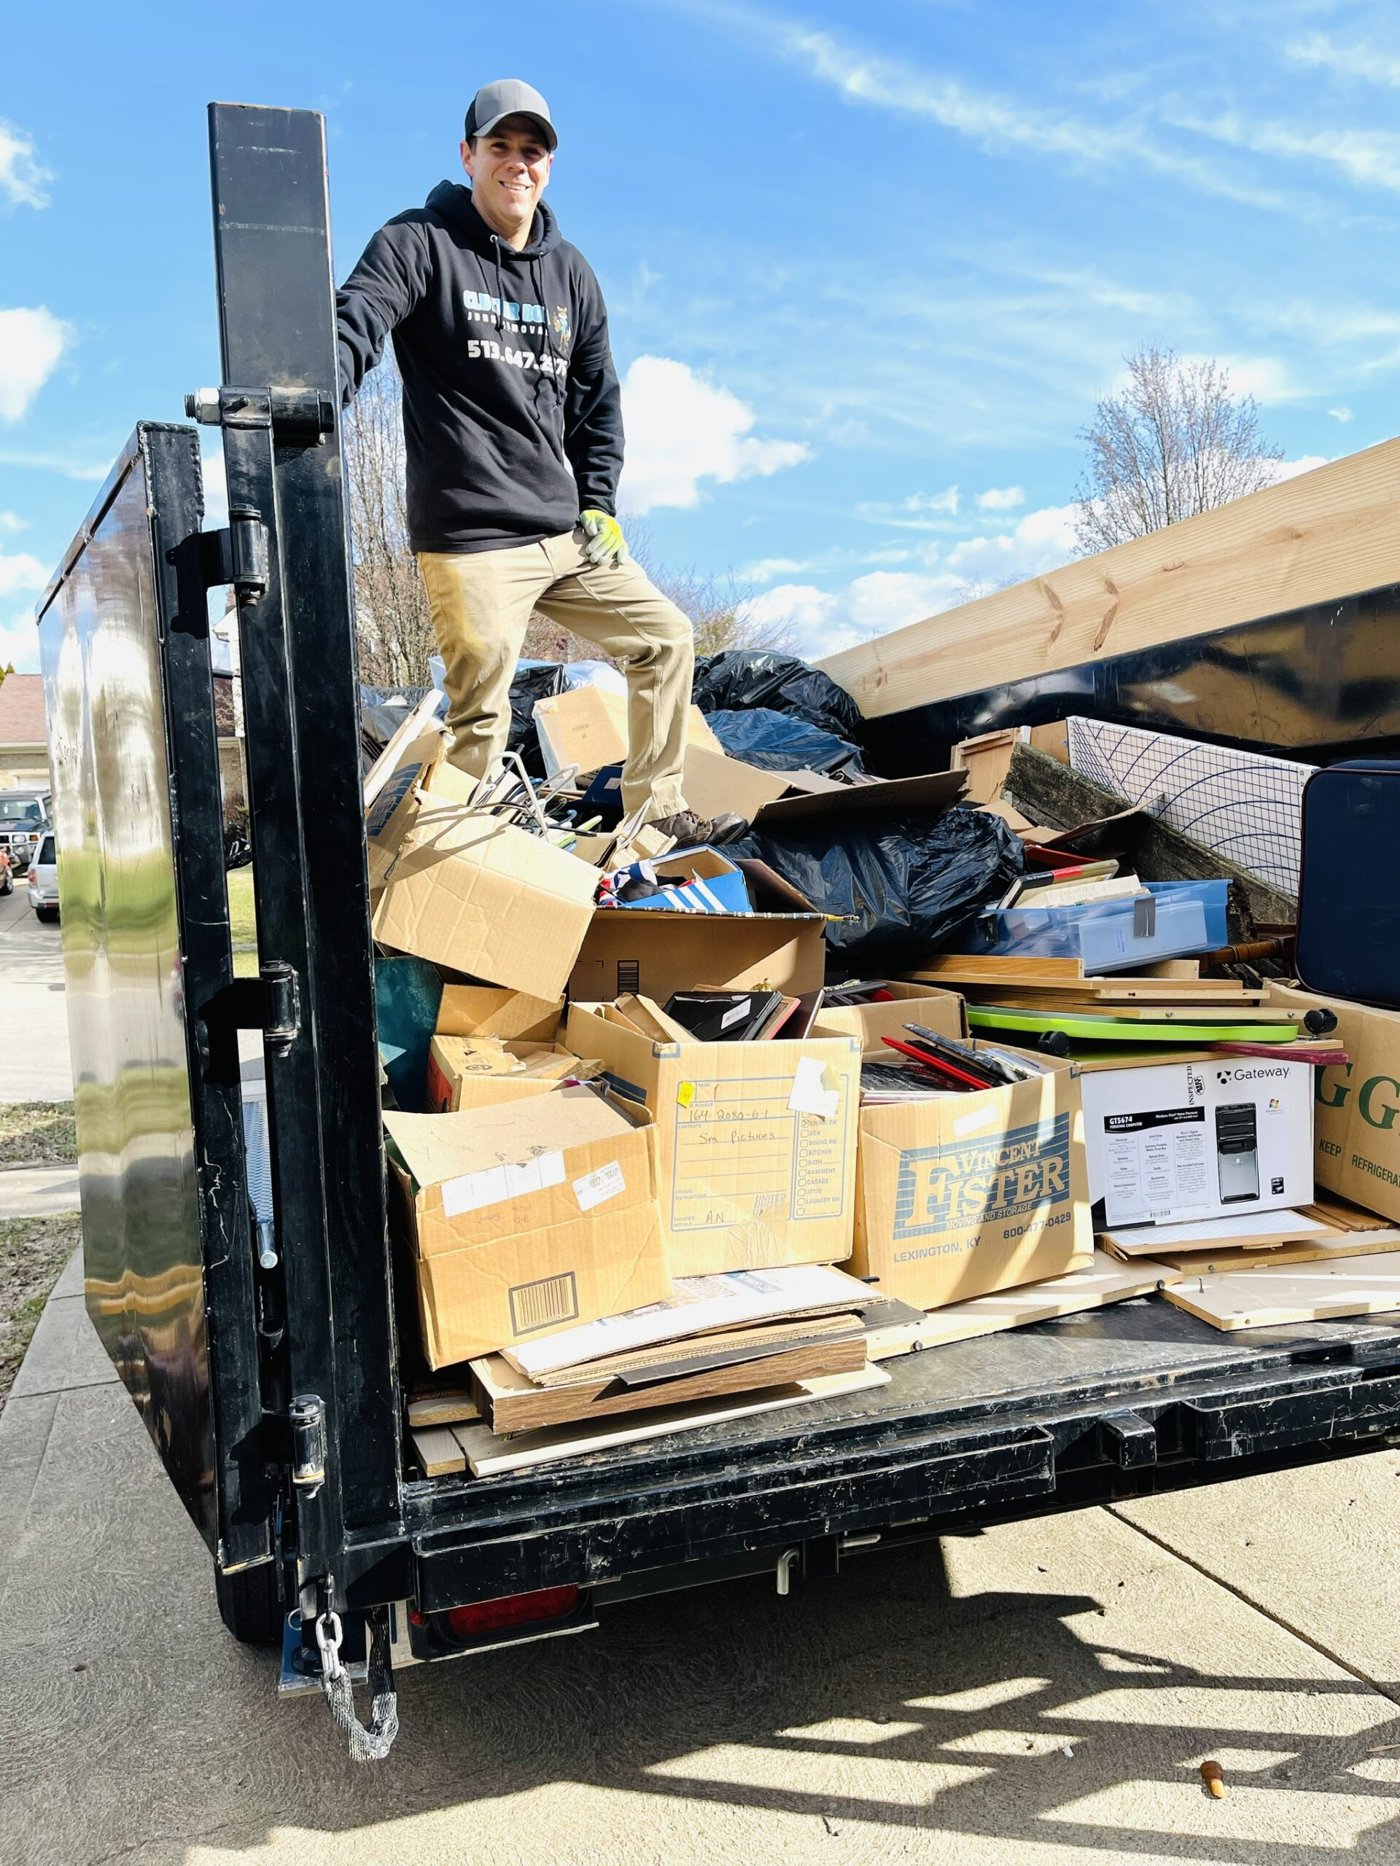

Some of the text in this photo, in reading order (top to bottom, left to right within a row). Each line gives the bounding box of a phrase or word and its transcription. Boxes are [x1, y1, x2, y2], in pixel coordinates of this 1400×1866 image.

[1234, 1067, 1290, 1081] Gateway
[1109, 1116, 1133, 1125] GT5674
[731, 1130, 776, 1144] Pictures
[1319, 1138, 1342, 1157] KEEP
[958, 1139, 1042, 1173] VINCENT
[905, 1156, 1066, 1229] FISTER
[946, 1202, 1032, 1230] MOVING AND STORAGE
[1003, 1212, 1072, 1239] 800-477-0429
[893, 1236, 981, 1263] LEXINGTON, KY
